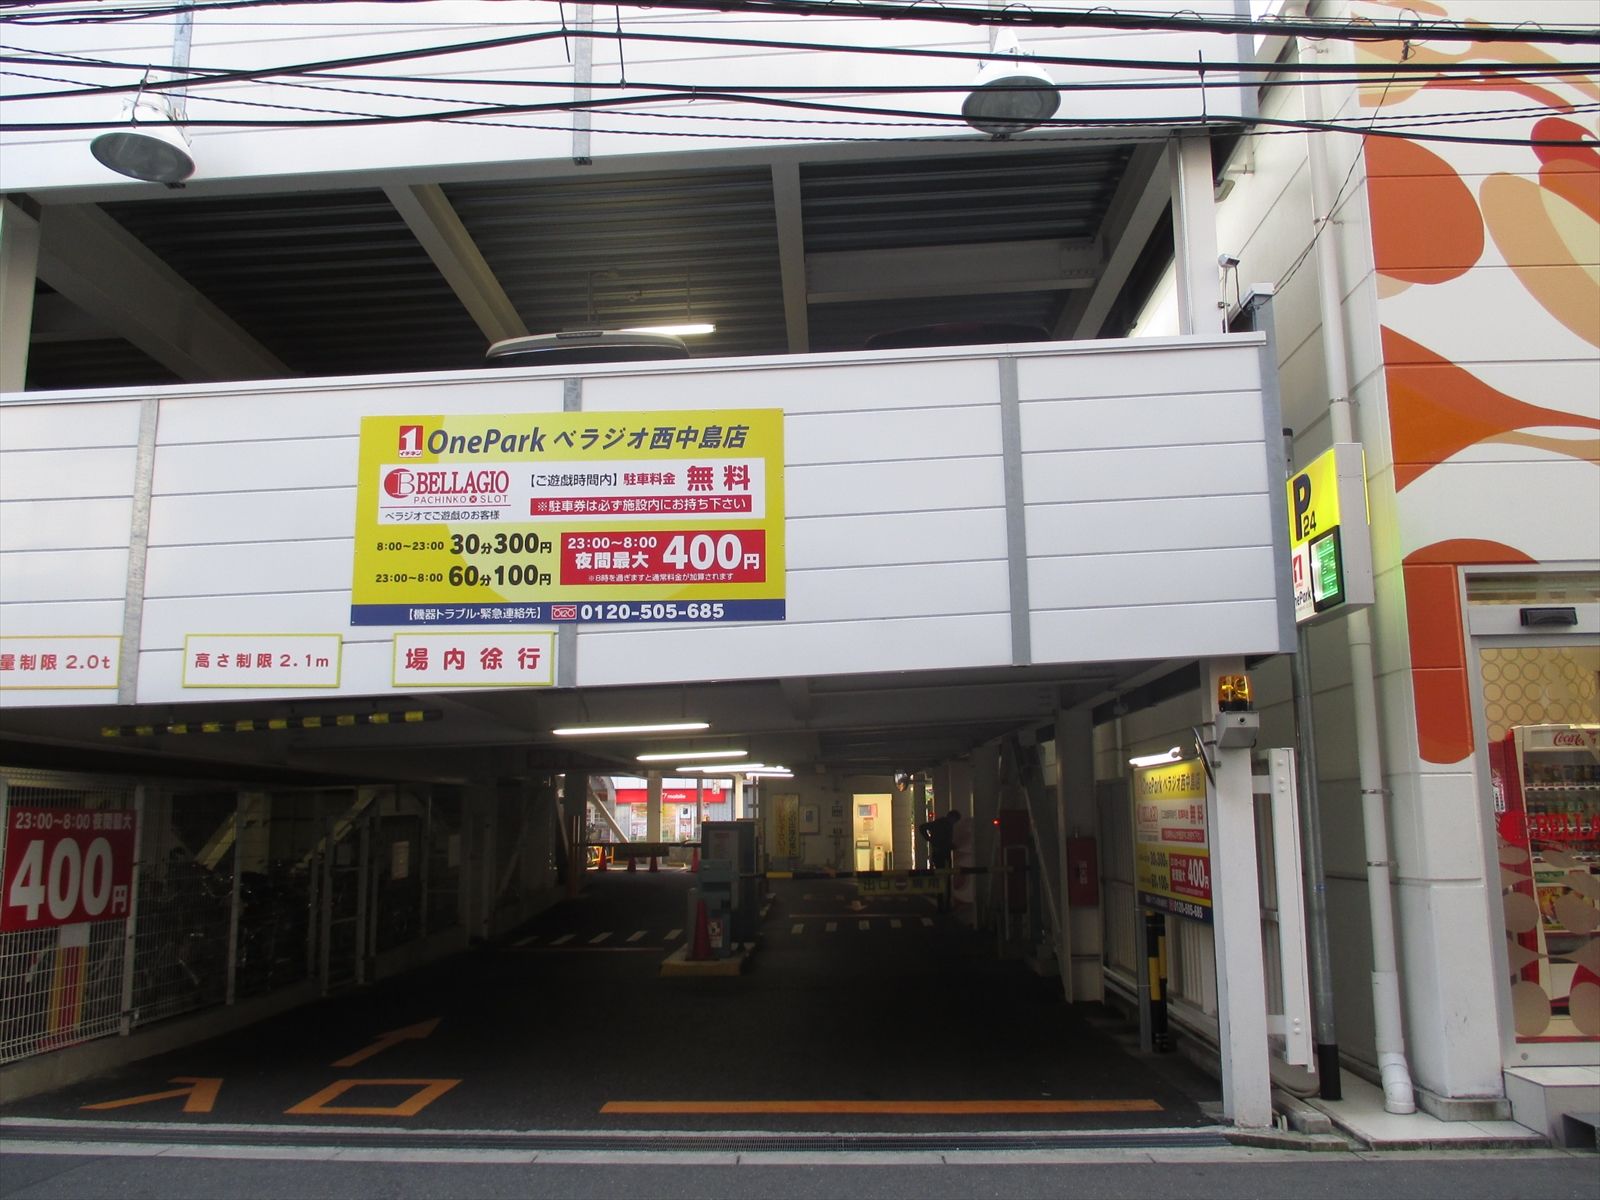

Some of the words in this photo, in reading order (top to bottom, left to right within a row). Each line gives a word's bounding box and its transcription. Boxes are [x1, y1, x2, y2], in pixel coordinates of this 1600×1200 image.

[427, 427, 546, 454] OnePark
[554, 424, 749, 450] ベラジオ西中島店
[416, 470, 510, 494] BELLAGIO
[623, 472, 676, 486] 駐車料金
[687, 465, 751, 491] 無料
[413, 496, 467, 504] PACHINKO
[481, 495, 509, 503] SLOT
[1292, 473, 1312, 541] P
[385, 510, 500, 521] ベラジオでご遊戯のお客様
[1303, 510, 1317, 536] 24
[450, 533, 552, 554] 30分300円
[575, 551, 649, 569] 夜間最大
[662, 533, 760, 570] 400円
[449, 565, 552, 586] 60分100円
[581, 603, 725, 619] 0120-505-685
[65, 654, 111, 669] 2.0t
[194, 652, 273, 669] 高さ制限
[279, 652, 330, 669] 2.1m
[405, 647, 541, 670] 場内徐行
[9, 836, 129, 921] 400円
